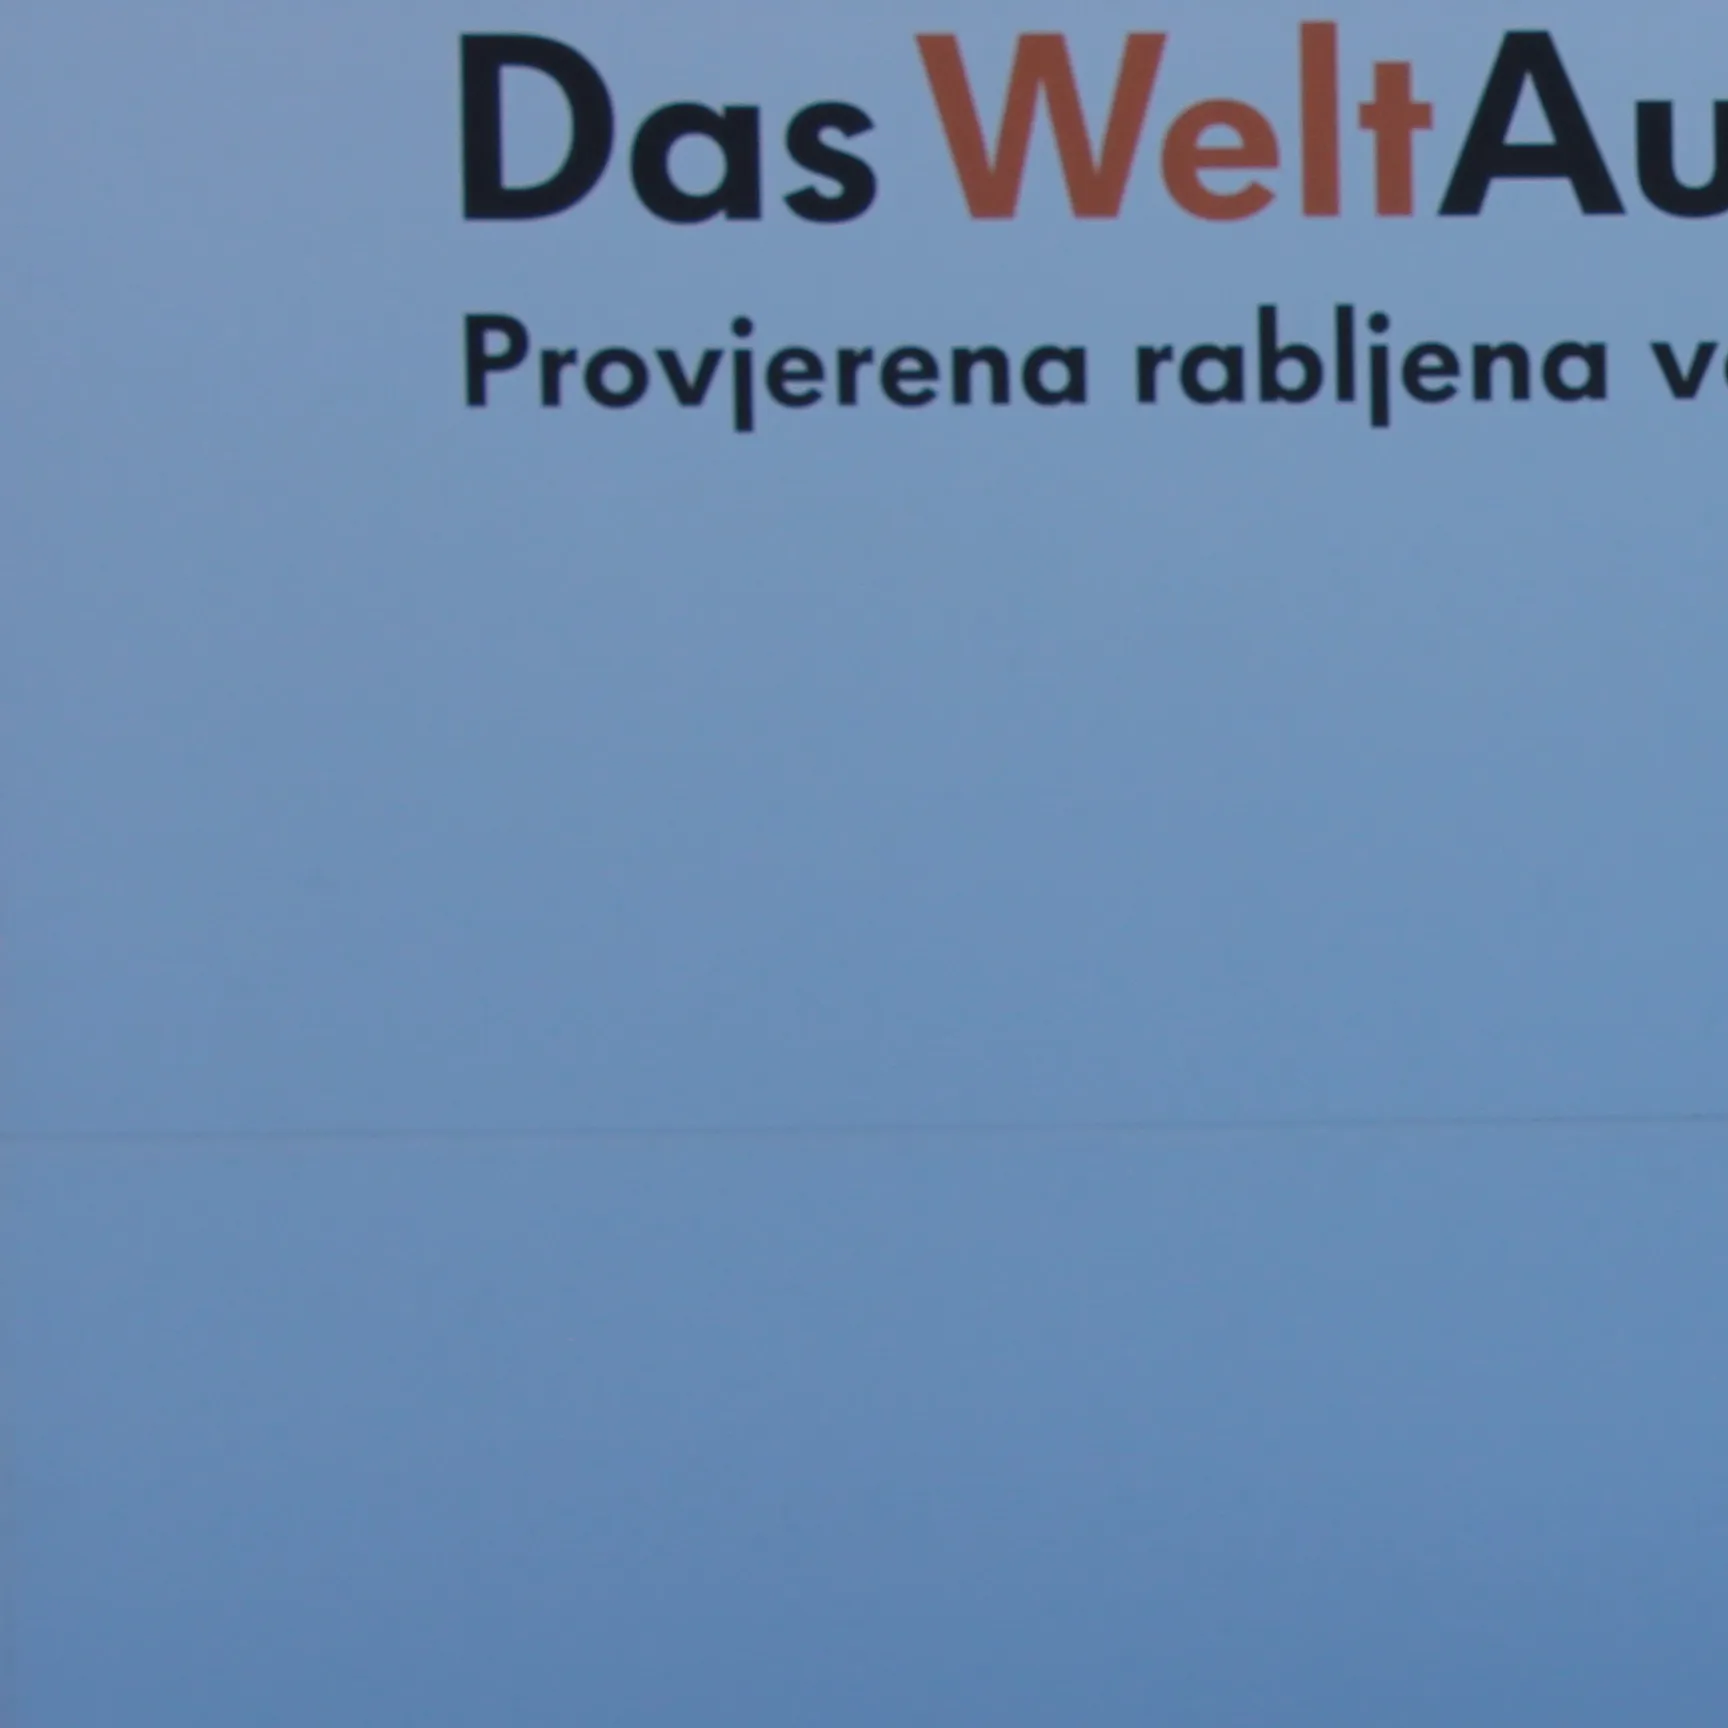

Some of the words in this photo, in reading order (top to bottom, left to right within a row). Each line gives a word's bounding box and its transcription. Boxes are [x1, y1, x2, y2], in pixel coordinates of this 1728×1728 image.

[460, 33, 876, 224] Das
[465, 314, 1086, 432] Provjerena
[1137, 304, 1606, 427] rabljena
